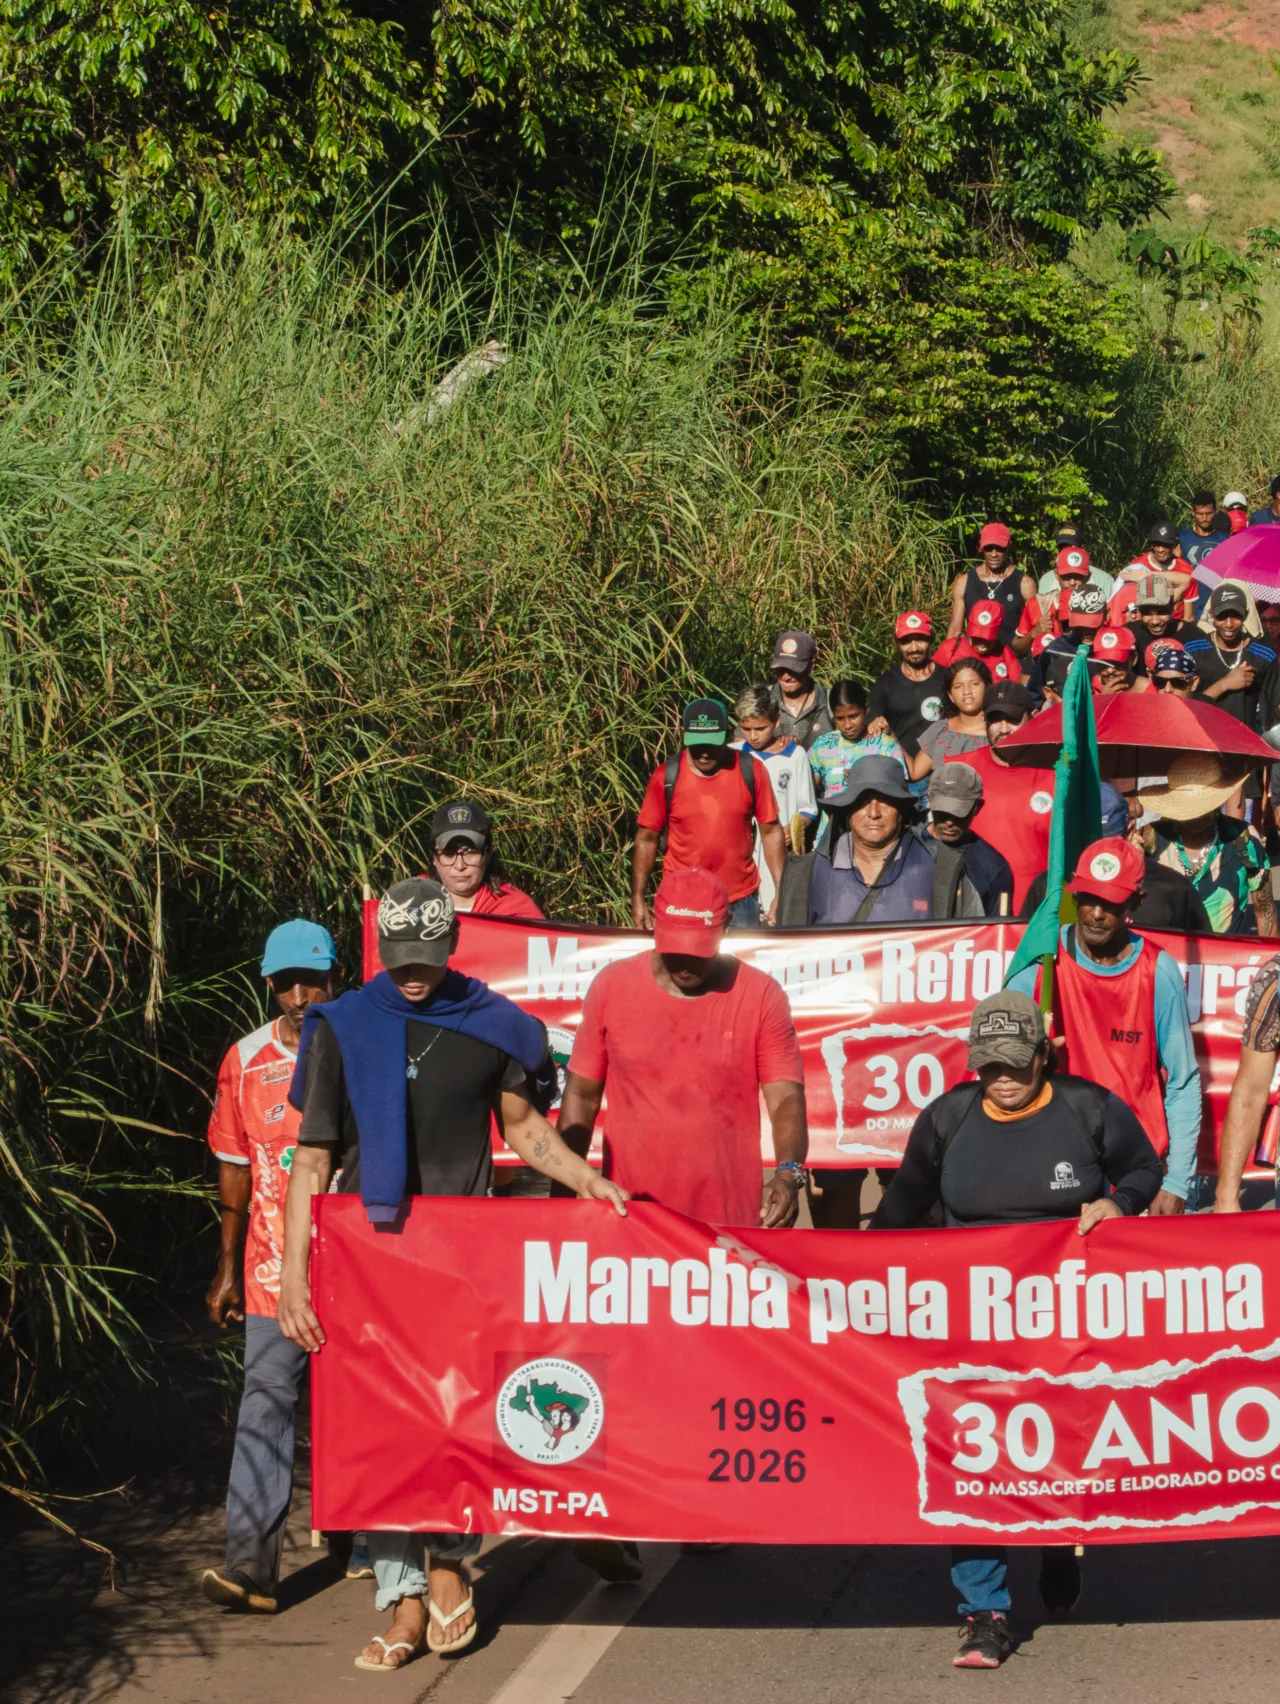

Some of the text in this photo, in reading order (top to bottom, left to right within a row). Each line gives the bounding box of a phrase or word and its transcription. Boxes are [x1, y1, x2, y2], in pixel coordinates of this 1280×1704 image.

[1110, 1027, 1144, 1044] MST
[863, 1053, 945, 1112] 30
[866, 1117, 888, 1131] DO
[524, 1241, 790, 1329] Marcha
[807, 1267, 948, 1344] pela
[969, 1260, 1265, 1341] Reforma
[500, 1393, 512, 1439] MOVIMENTO
[506, 1377, 518, 1391] DOS
[517, 1361, 579, 1378] TRABALHADORES
[710, 1397, 807, 1433] 1996
[952, 1402, 1055, 1474] 30
[707, 1448, 808, 1484] 2026
[956, 1480, 984, 1496] DO
[989, 1480, 1086, 1496] MASSACRE
[1091, 1478, 1114, 1494] DE
[1121, 1470, 1221, 1492] ELDORADO
[1228, 1465, 1265, 1482] DOS
[493, 1488, 609, 1518] MST-PA
